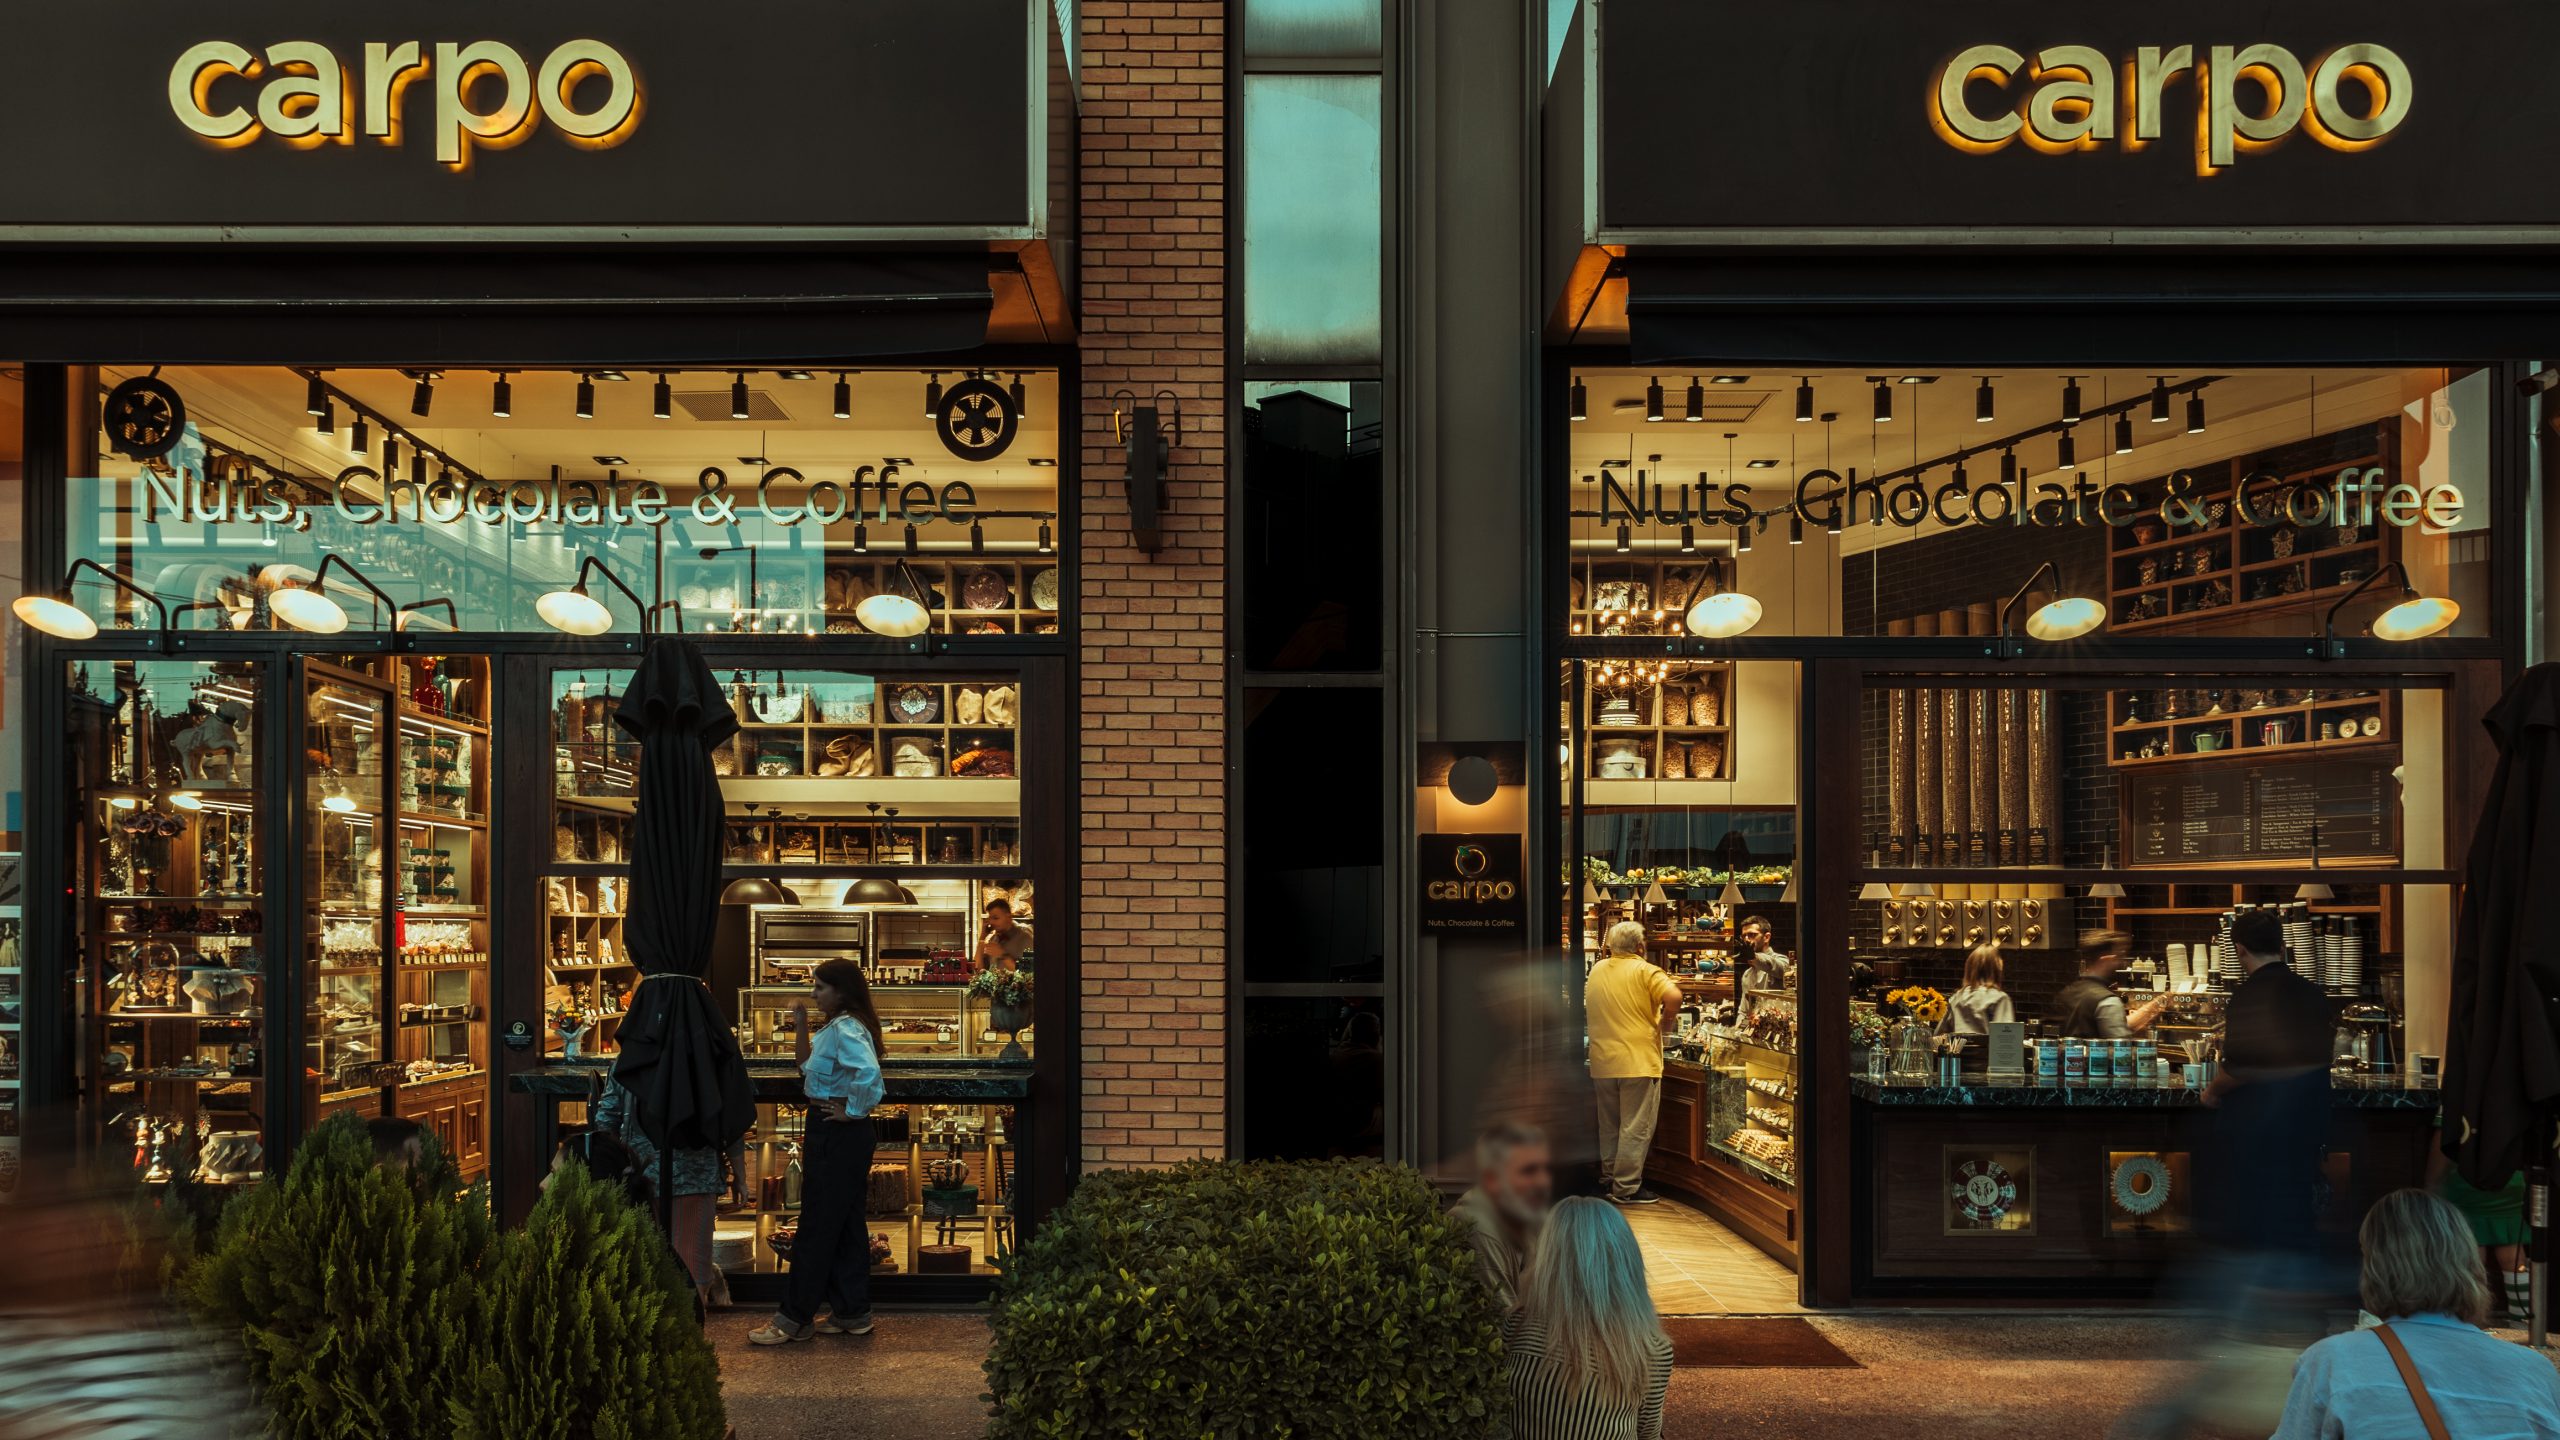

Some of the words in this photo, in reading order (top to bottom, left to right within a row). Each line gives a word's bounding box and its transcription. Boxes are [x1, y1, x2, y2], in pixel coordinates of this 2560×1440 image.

[168, 38, 638, 163] carpo
[1938, 42, 2414, 168] carpo
[139, 465, 314, 532] Nuts,
[332, 464, 672, 525] Chocolate
[691, 466, 742, 526] &
[758, 465, 978, 525] Coffee
[1600, 469, 1768, 536] Nuts,
[1794, 467, 2139, 527] Chocolate
[2160, 468, 2208, 527] &
[2235, 467, 2465, 527] Coffee
[1428, 881, 1515, 904] carpo
[1447, 919, 1483, 927] Chocolate
[1484, 919, 1490, 927] &
[1491, 919, 1515, 927] Coffee
